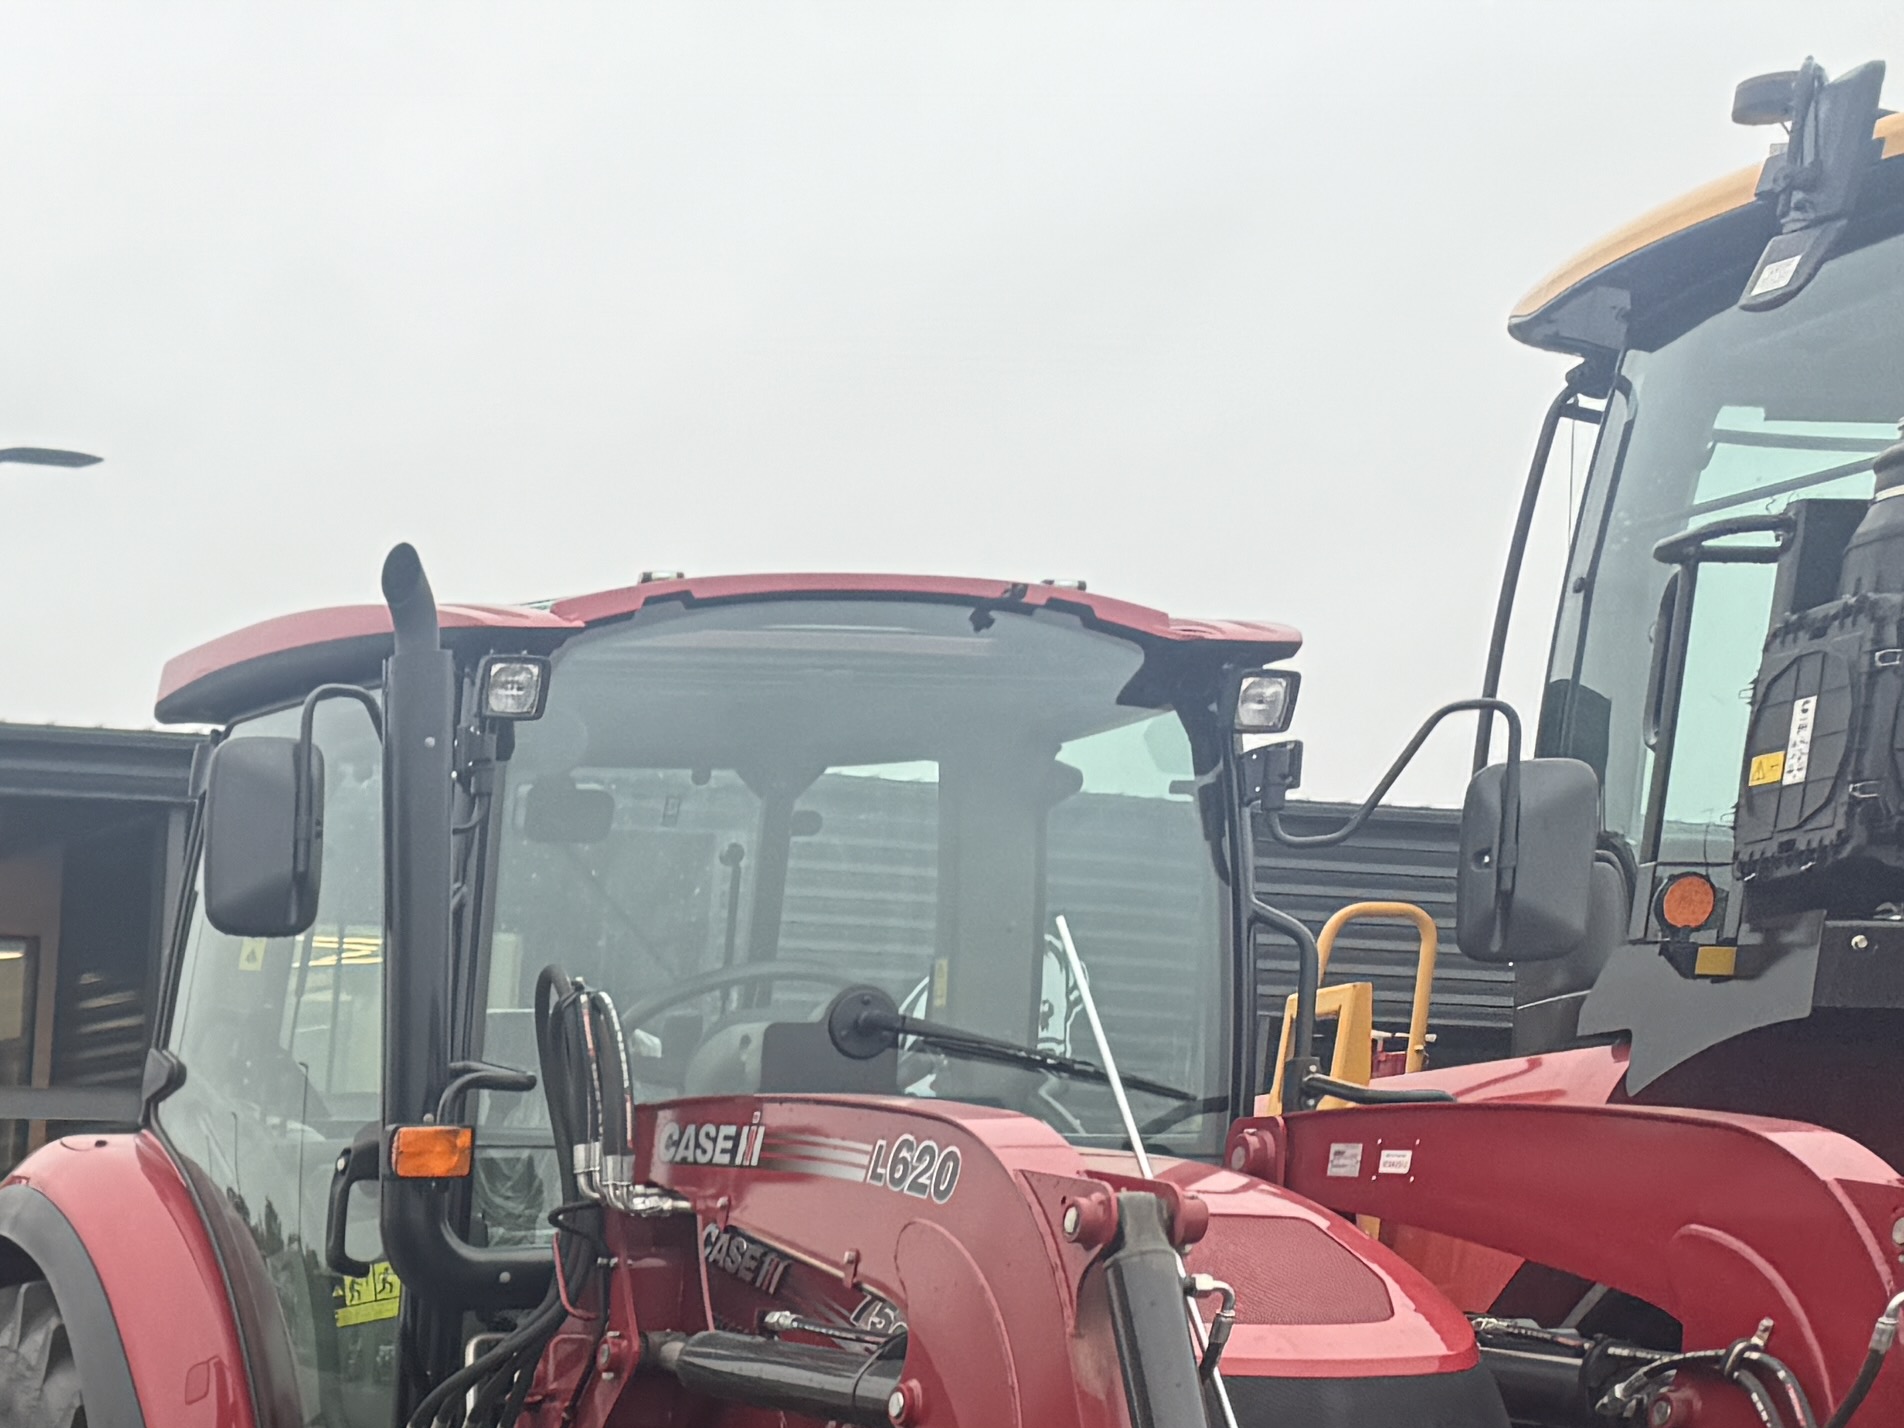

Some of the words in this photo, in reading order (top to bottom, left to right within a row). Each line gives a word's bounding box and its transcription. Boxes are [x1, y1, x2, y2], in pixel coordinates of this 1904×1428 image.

[659, 1121, 737, 1166] CASE
[866, 1133, 962, 1204] L620
[702, 1222, 764, 1282] CASE
